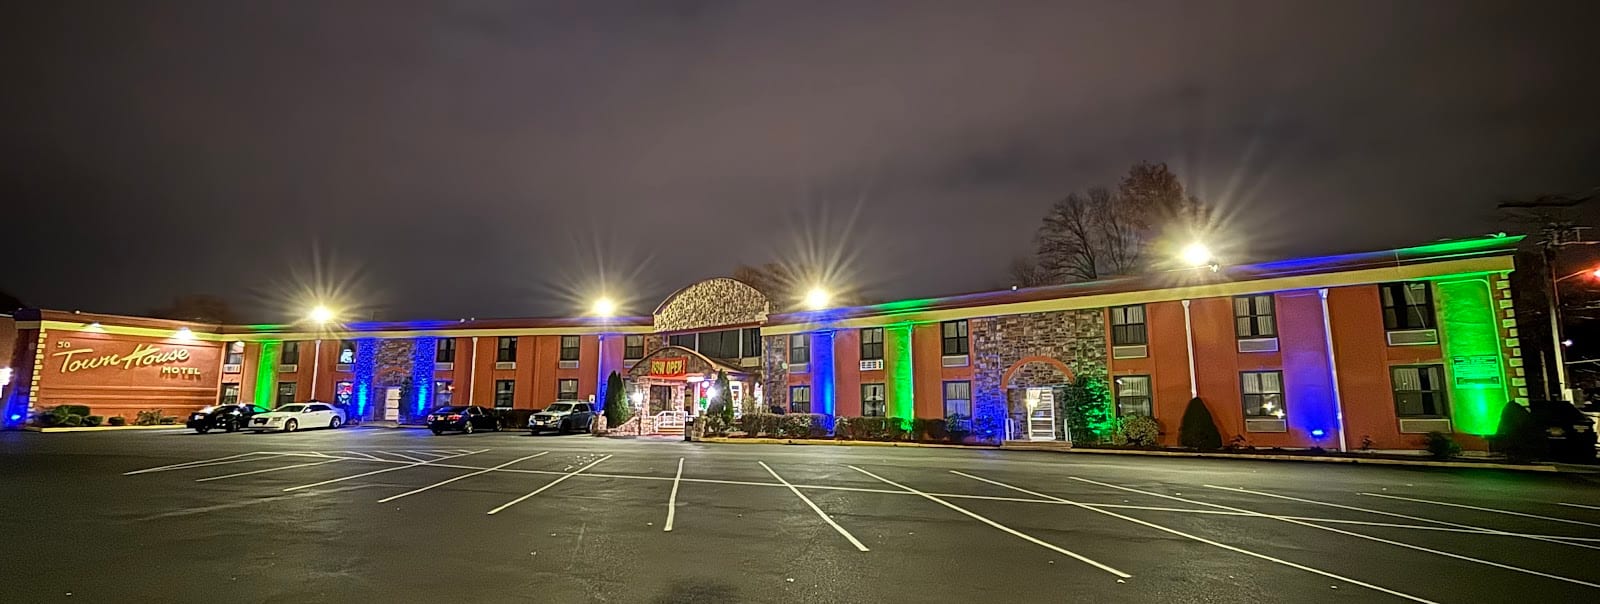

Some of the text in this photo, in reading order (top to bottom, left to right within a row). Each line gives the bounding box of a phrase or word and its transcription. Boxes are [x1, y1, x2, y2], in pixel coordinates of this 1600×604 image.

[52, 344, 190, 373] Town House
[162, 366, 201, 375] MOTEL
[651, 360, 665, 375] NOW
